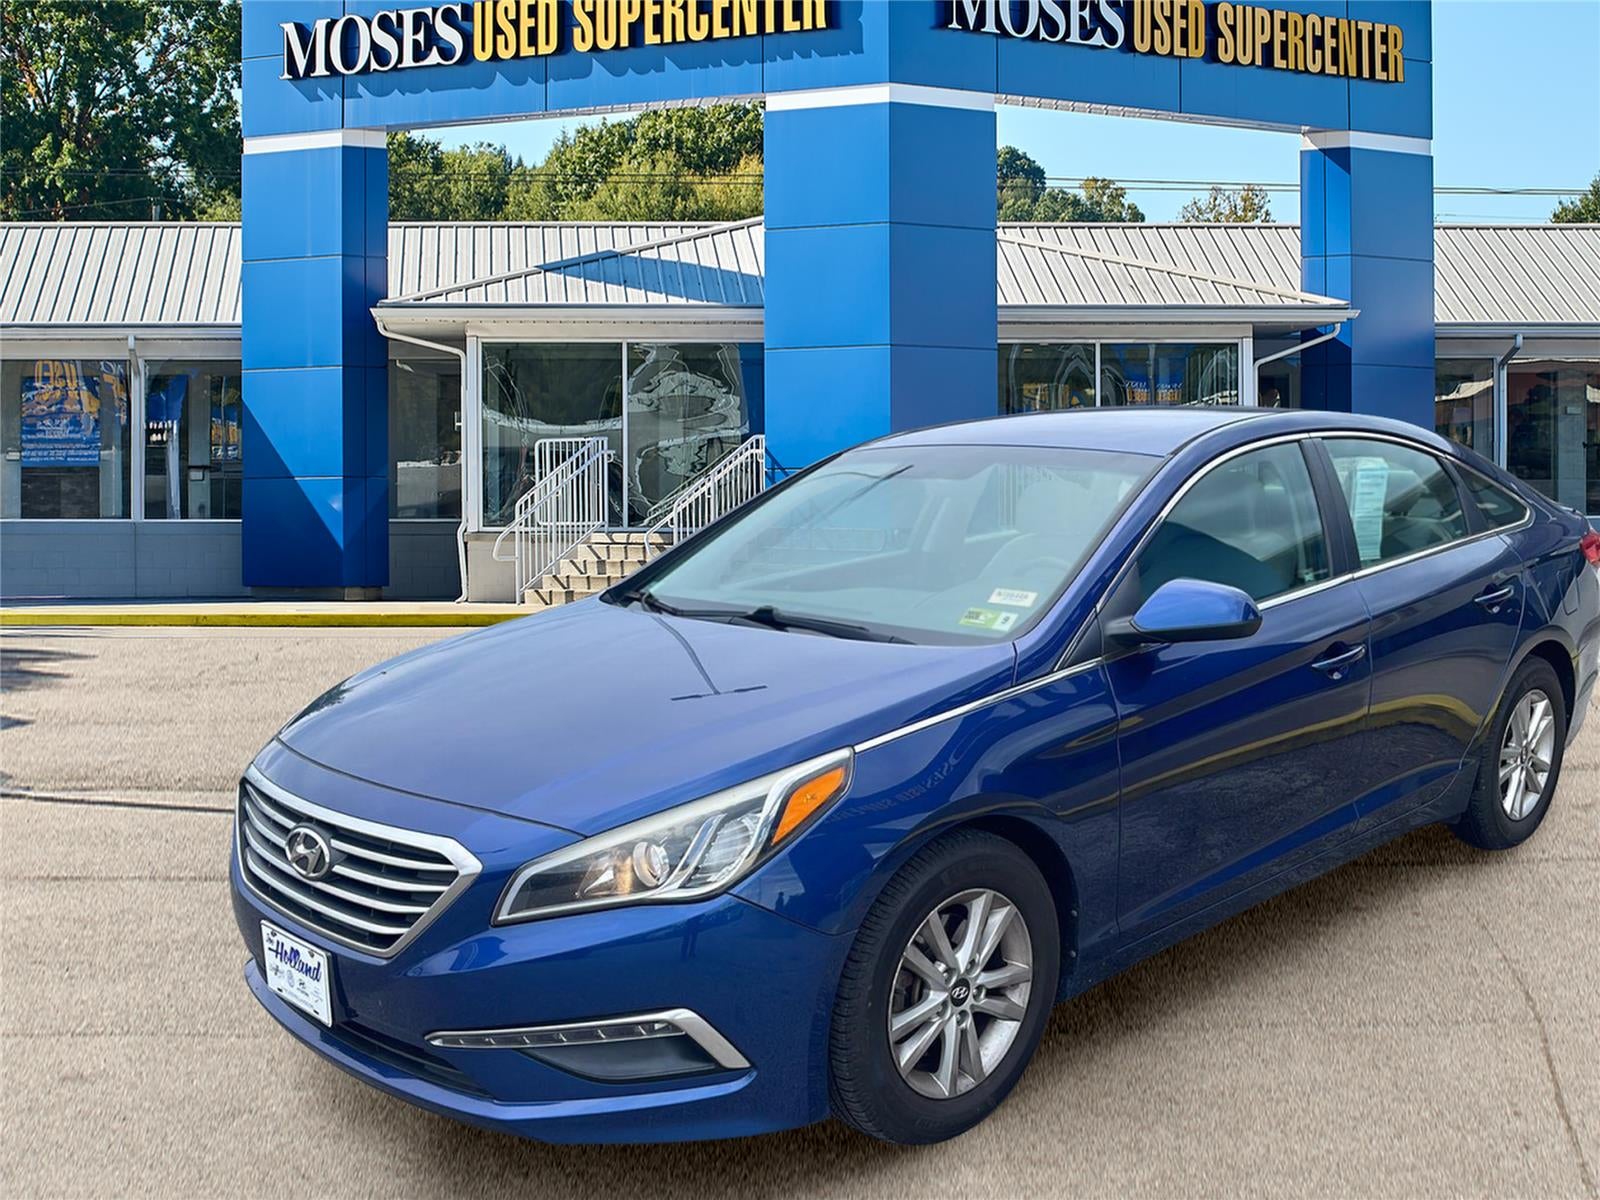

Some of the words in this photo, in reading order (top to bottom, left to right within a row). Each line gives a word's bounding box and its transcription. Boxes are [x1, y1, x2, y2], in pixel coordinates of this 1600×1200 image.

[278, 3, 464, 80] MOSES
[472, 0, 558, 62] USED
[1133, 0, 1206, 58] USED
[1217, 1, 1405, 82] SUPERCENTER
[268, 938, 322, 983] Holland
